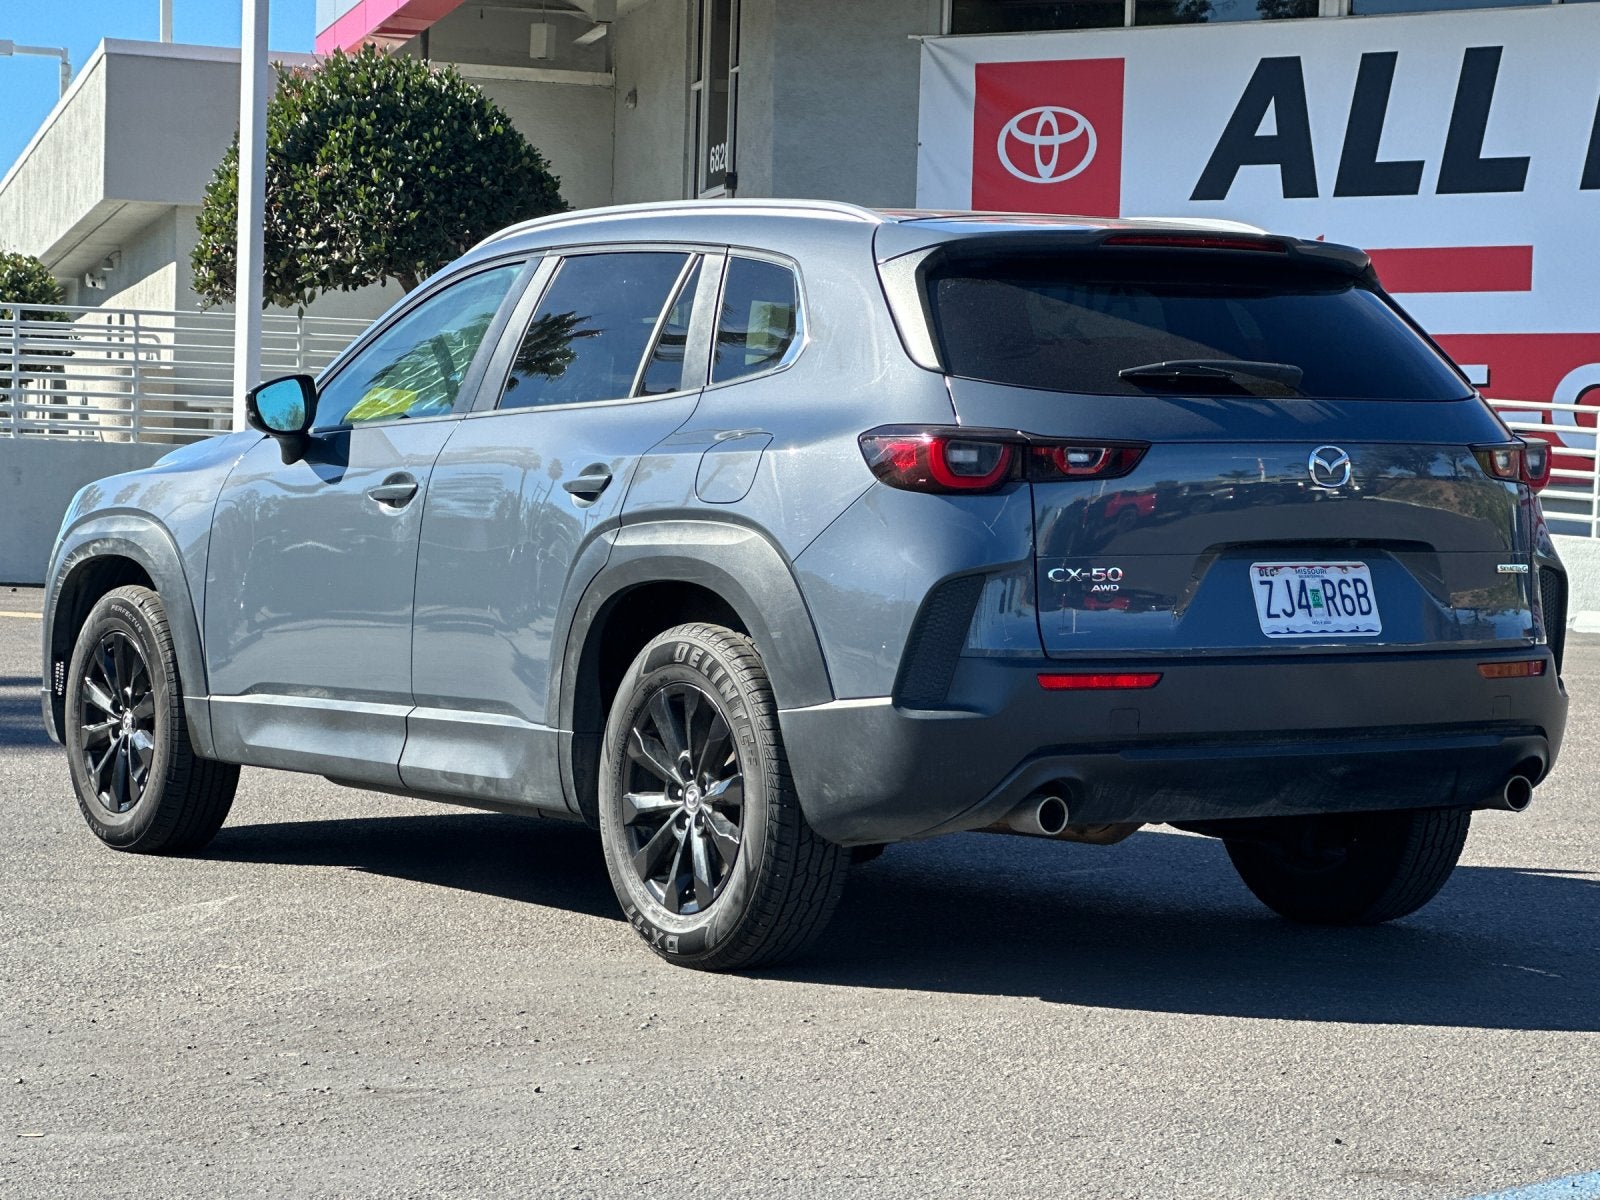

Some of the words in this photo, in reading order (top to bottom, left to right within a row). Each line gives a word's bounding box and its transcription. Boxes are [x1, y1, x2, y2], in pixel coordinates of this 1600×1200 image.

[1189, 45, 1531, 201] ALL
[1048, 567, 1123, 582] CX-50
[1259, 568, 1275, 577] DEC
[1091, 584, 1120, 592] AWD
[1259, 579, 1312, 619] ZJ4
[1321, 578, 1372, 617] R6B
[111, 604, 143, 633] PERFECTUS
[673, 642, 756, 747] DELINTE
